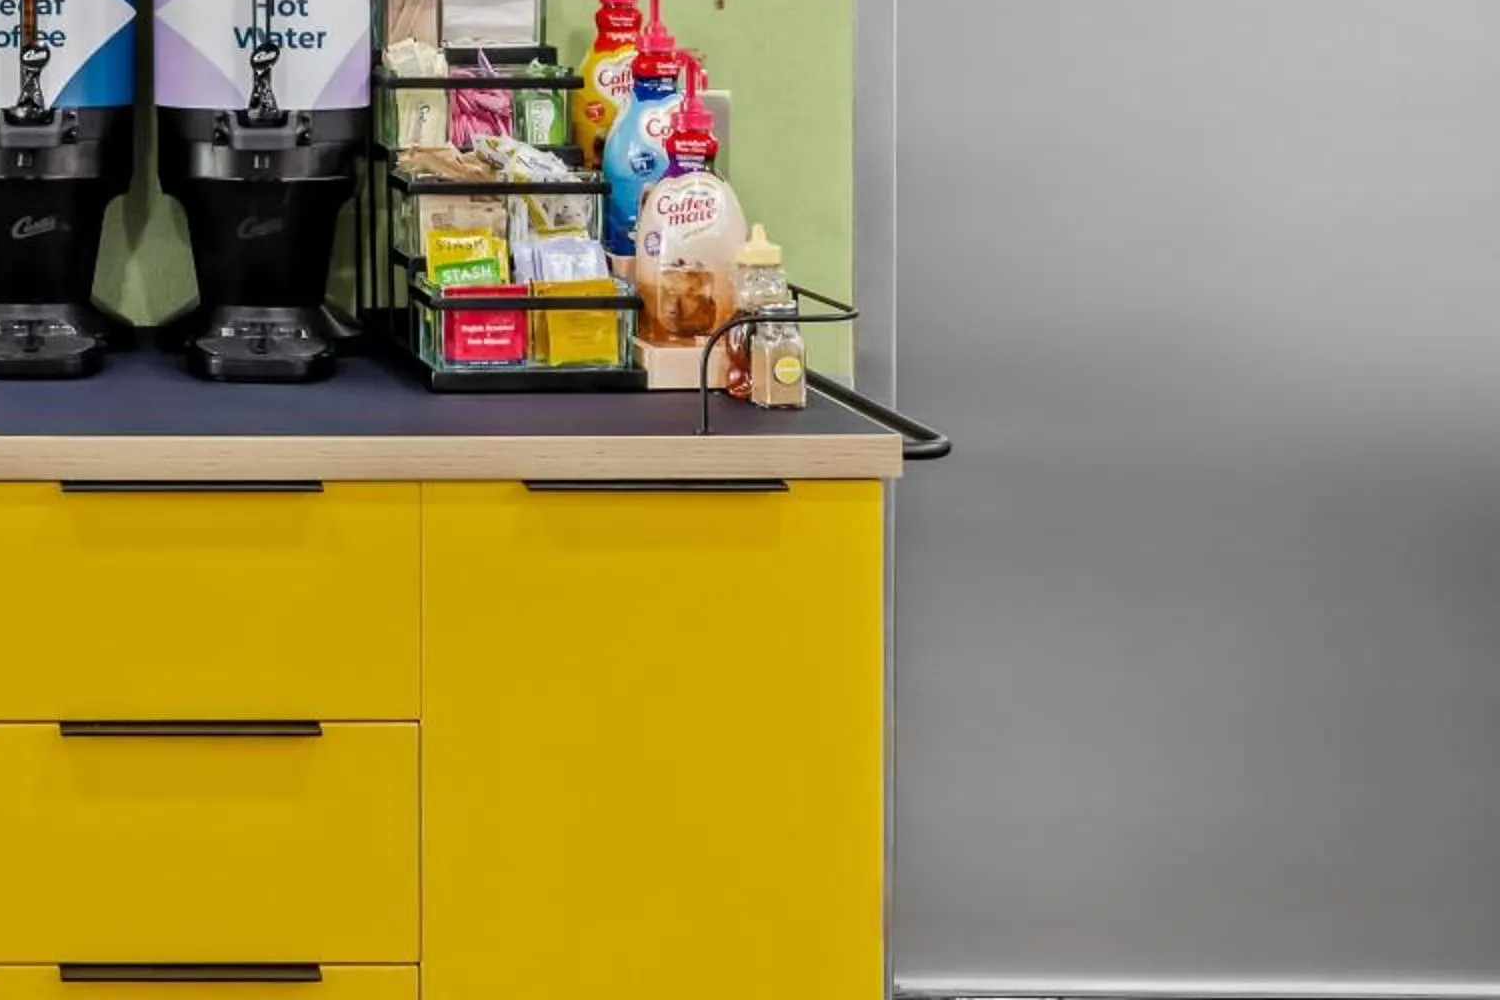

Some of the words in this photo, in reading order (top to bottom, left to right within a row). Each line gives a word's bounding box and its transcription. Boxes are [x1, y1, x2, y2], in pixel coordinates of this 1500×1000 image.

[598, 69, 632, 87] Coff
[657, 195, 715, 215] Coffee
[668, 210, 715, 225] mate
[441, 263, 492, 284] STASH
